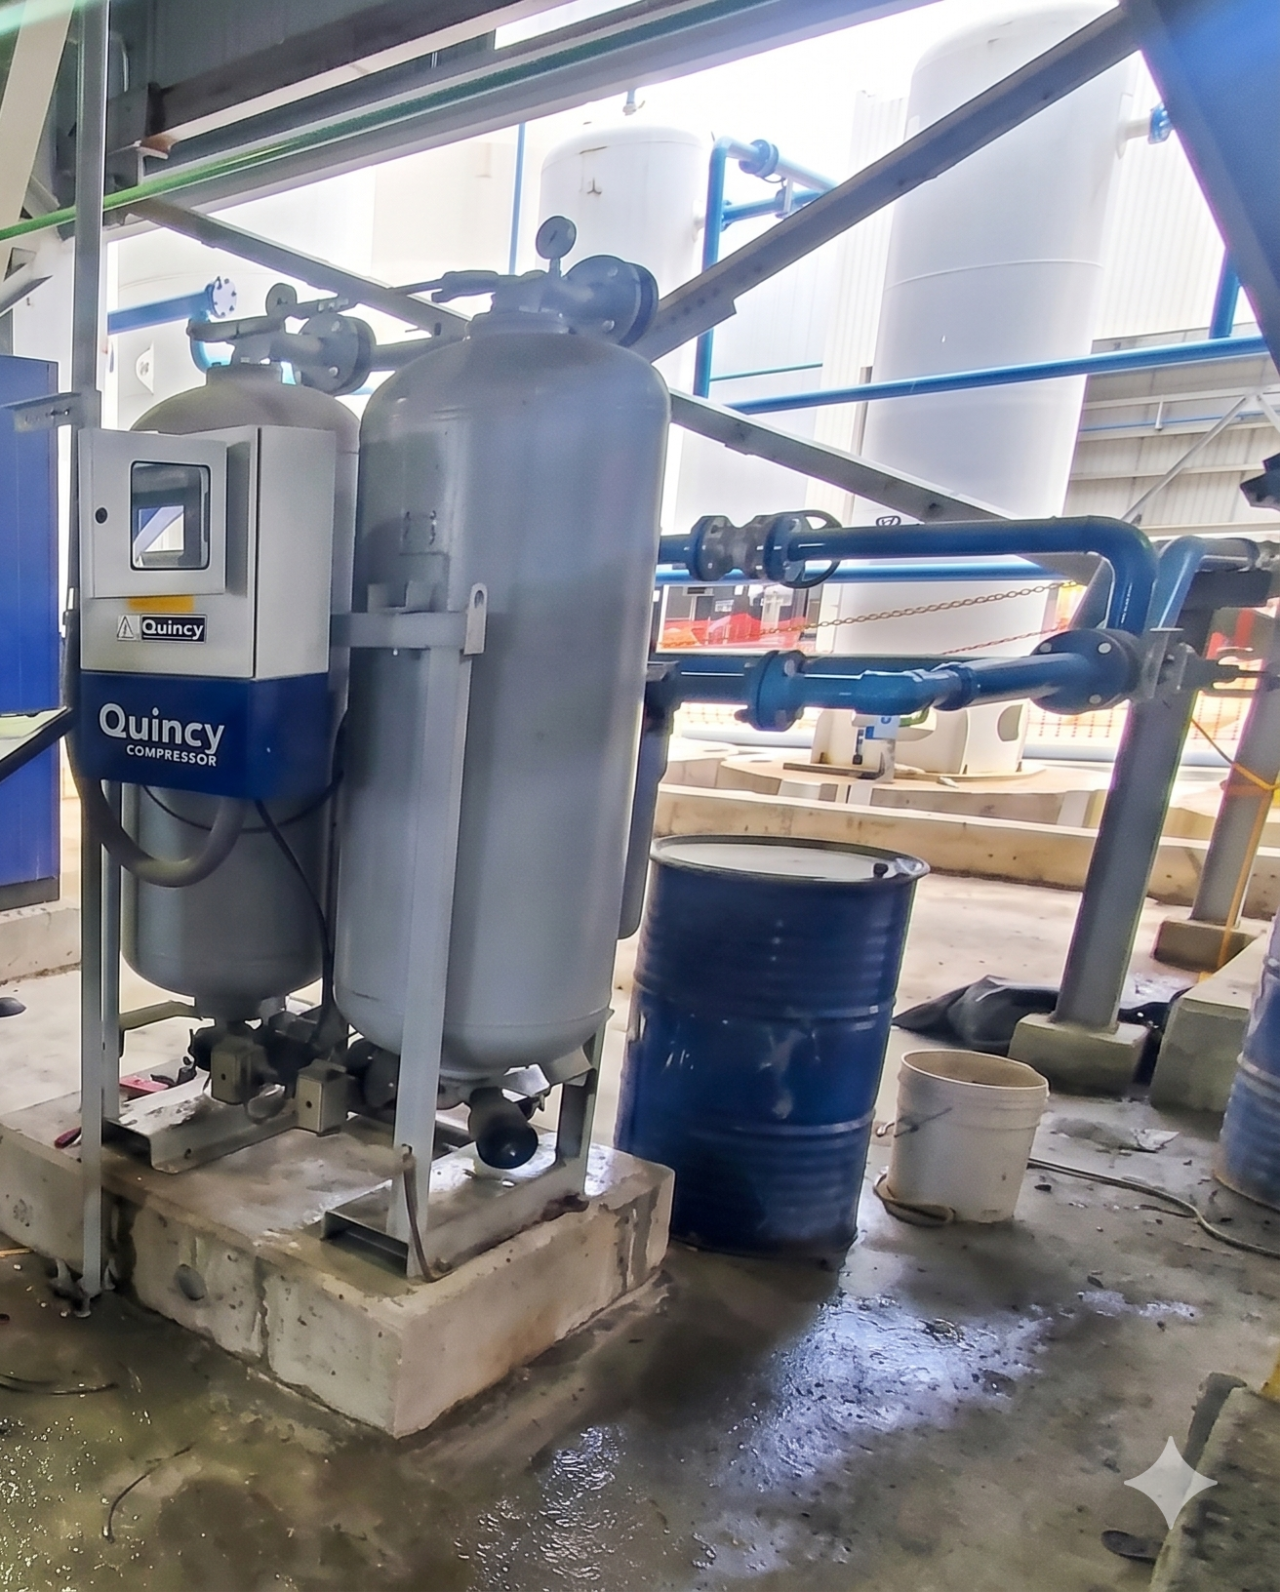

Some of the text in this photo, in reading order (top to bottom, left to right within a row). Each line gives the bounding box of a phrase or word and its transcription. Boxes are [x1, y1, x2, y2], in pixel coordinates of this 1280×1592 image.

[142, 619, 205, 640] Quincy
[99, 703, 225, 754] Quincy
[126, 744, 217, 767] COMPRESSOR
